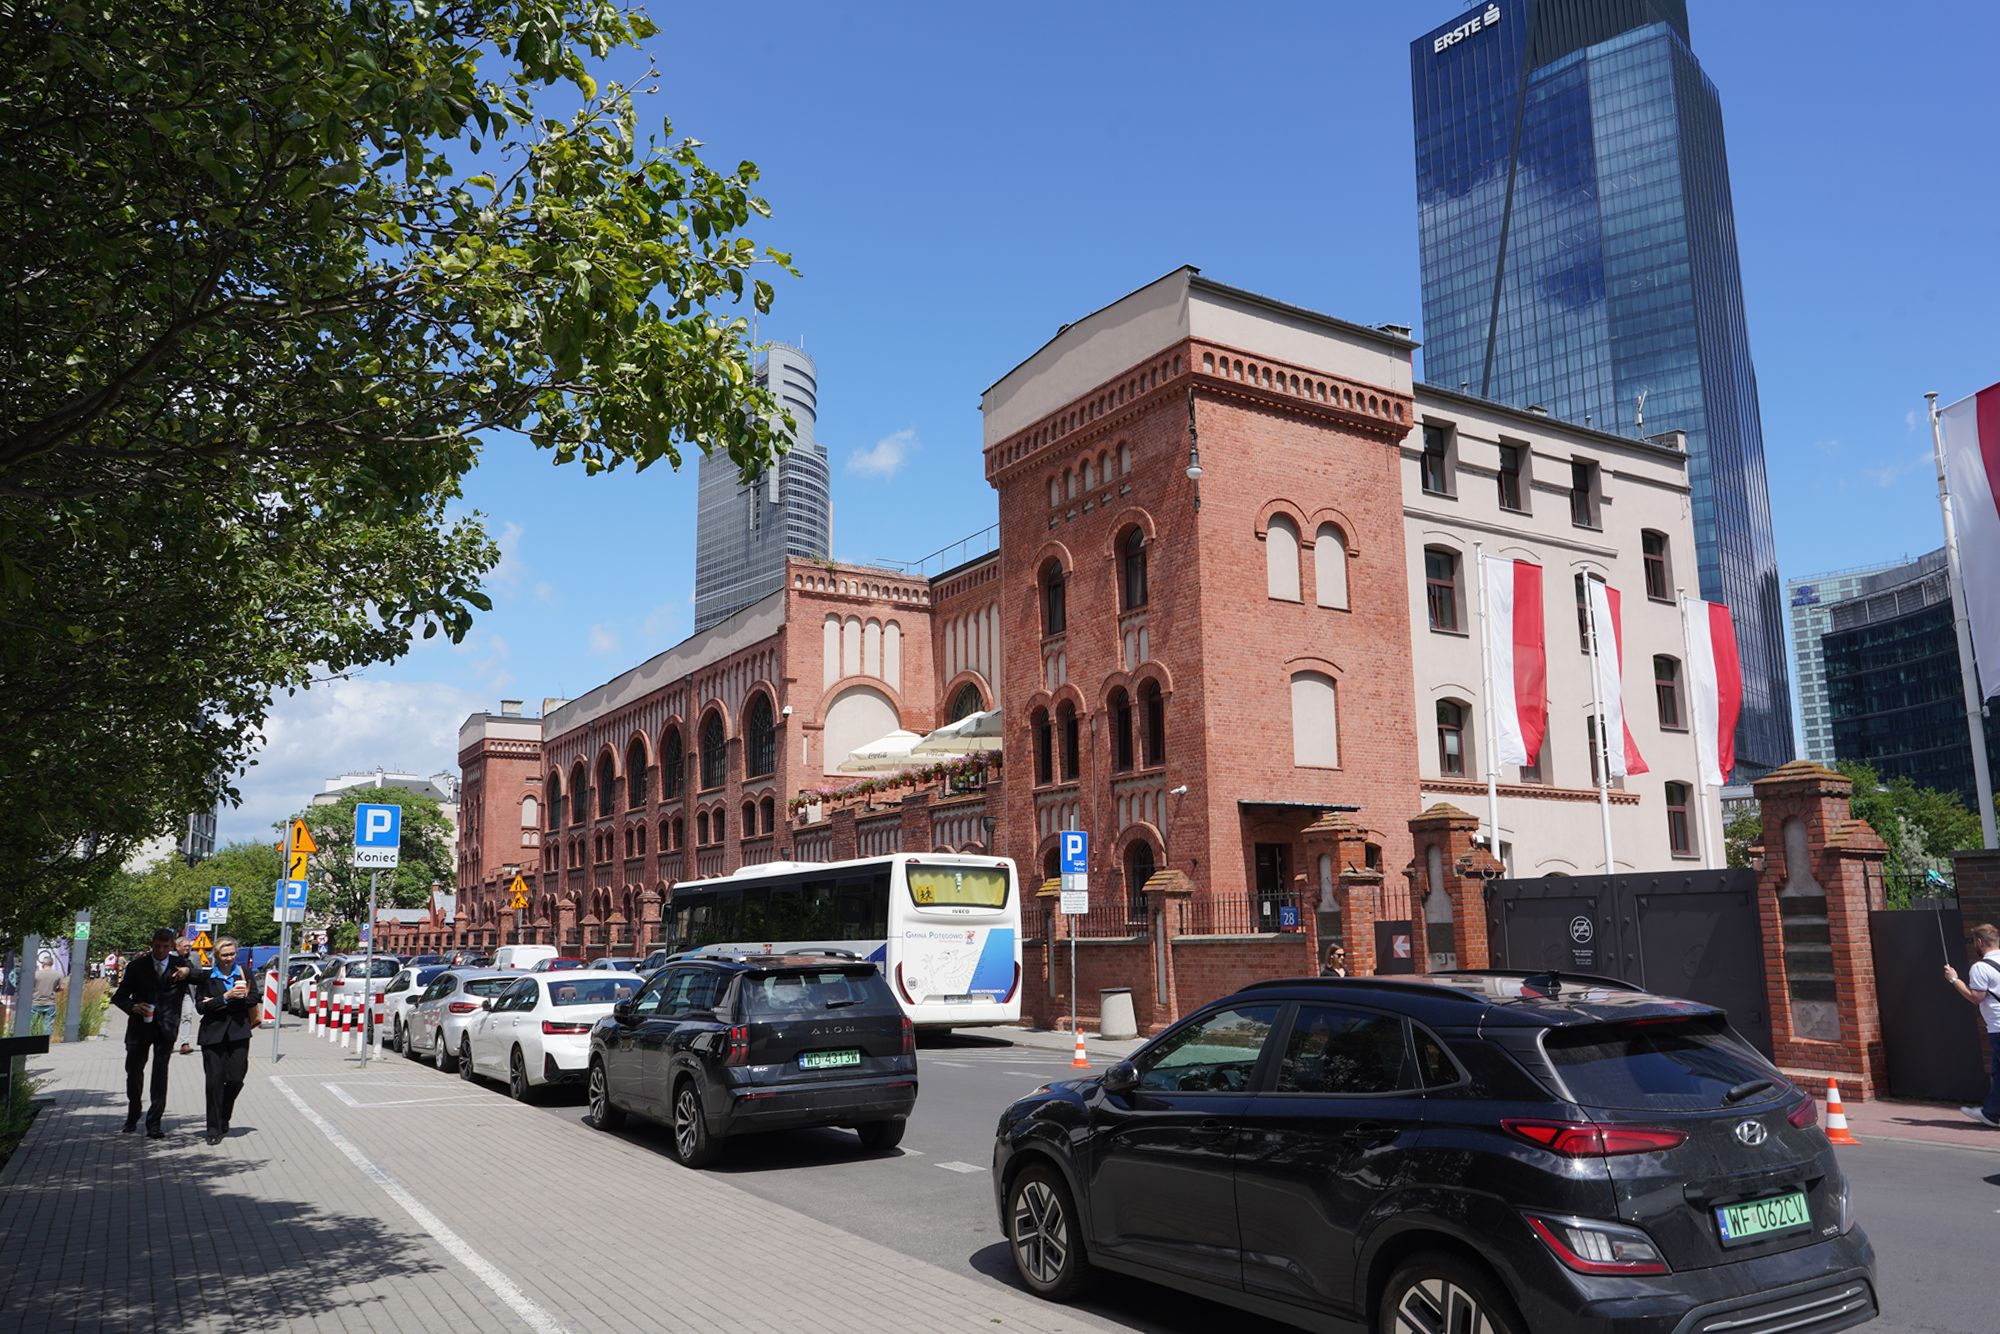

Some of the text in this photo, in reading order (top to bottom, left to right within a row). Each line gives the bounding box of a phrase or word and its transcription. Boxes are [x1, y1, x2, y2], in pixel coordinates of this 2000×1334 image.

[1434, 16, 1481, 53] ERSTE
[365, 809, 392, 842] P
[1066, 834, 1083, 861] P
[356, 851, 396, 863] Koniec
[214, 888, 227, 903] P
[199, 911, 209, 923] P
[1283, 912, 1295, 926] 28
[811, 1025, 856, 1035] AION
[805, 1050, 858, 1066] WD 4313W
[1728, 1194, 1805, 1236] WF 062CV
